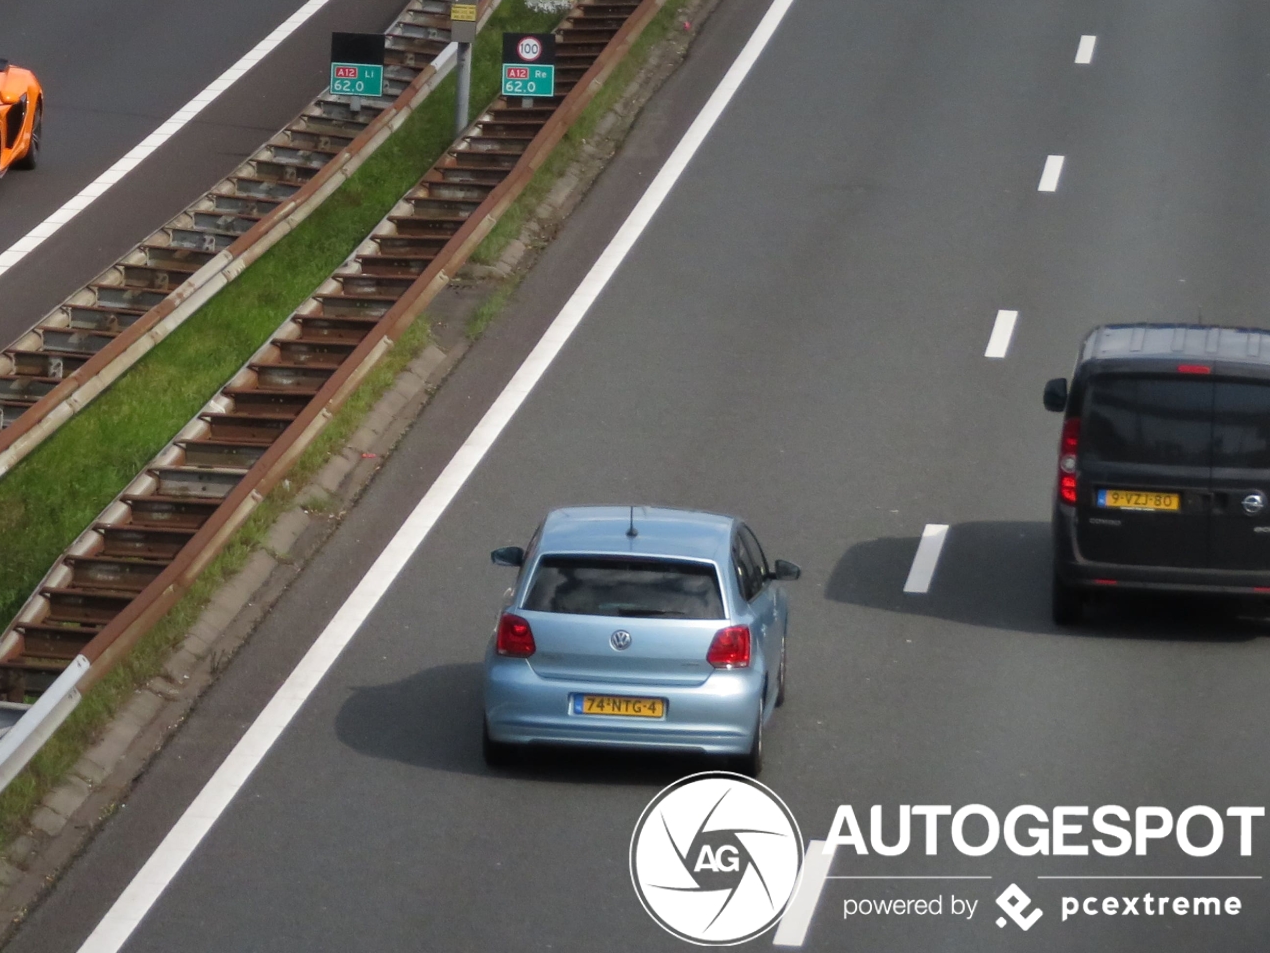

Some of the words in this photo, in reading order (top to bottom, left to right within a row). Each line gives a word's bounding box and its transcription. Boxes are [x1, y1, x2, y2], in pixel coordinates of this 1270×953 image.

[520, 43, 539, 54] 100
[337, 68, 355, 77] A12
[509, 69, 526, 78] A12
[535, 70, 547, 78] Re
[334, 80, 364, 92] 62.0
[505, 81, 536, 93] 62.0
[1111, 492, 1172, 507] 9-VZJ-80
[586, 697, 657, 714] 74-NTG-4
